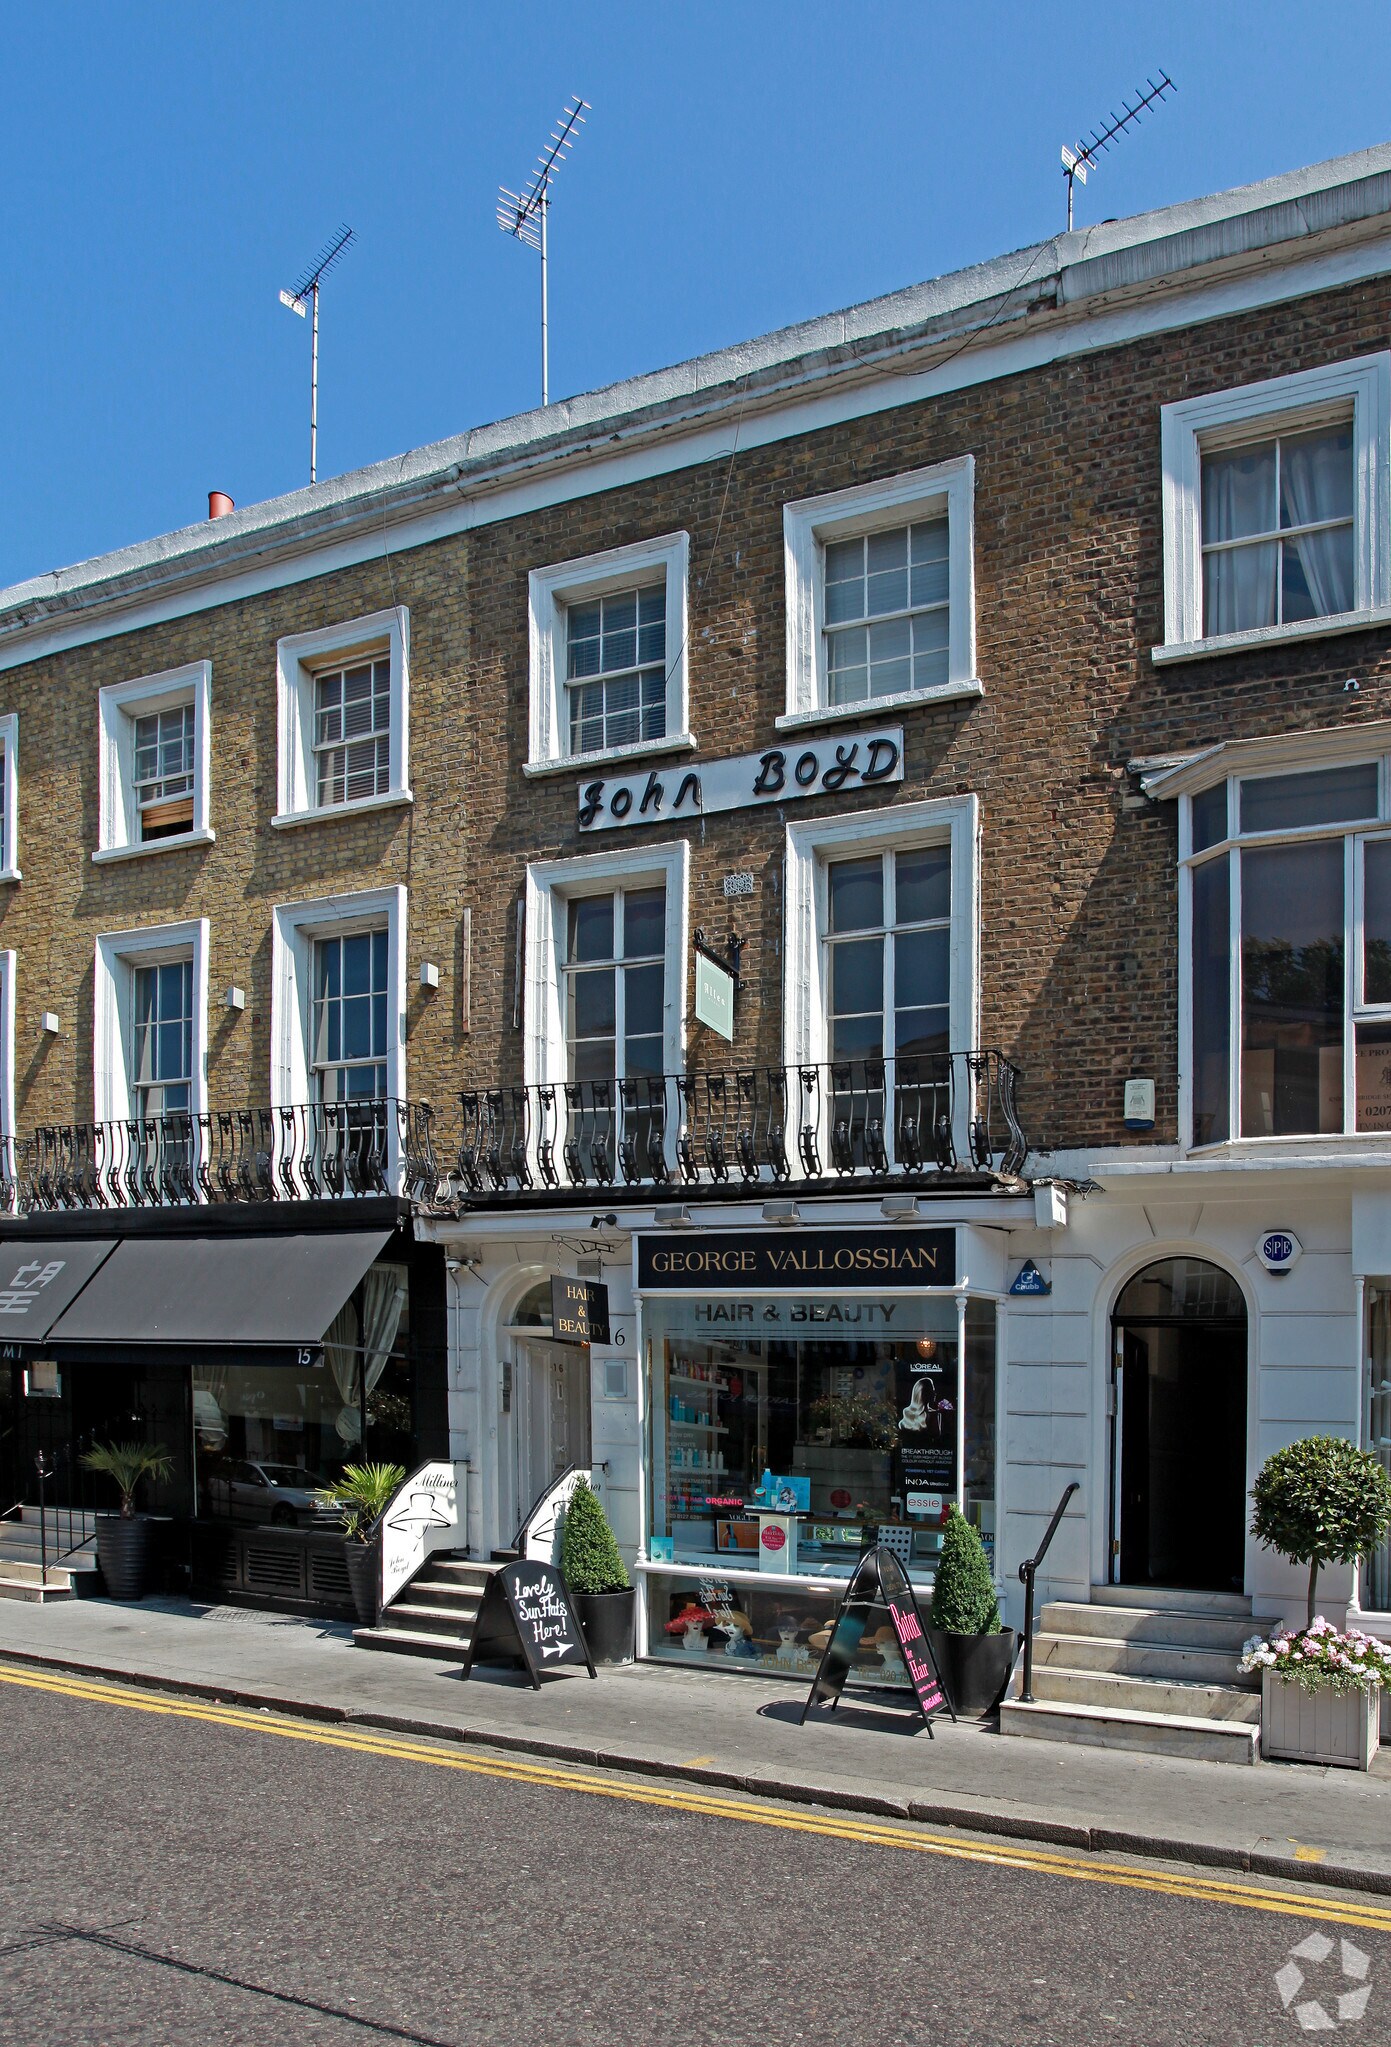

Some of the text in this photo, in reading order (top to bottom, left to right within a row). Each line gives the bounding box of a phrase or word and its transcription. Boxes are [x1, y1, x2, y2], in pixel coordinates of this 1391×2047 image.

[652, 1247, 938, 1272] GEORGE VALLOSSIAN
[567, 1285, 595, 1302] HAIR
[578, 1305, 586, 1317] &
[695, 1303, 897, 1322] HAIR & BEAUTY
[559, 1318, 605, 1336] BEAUTY
[298, 1348, 311, 1364] 15
[901, 1448, 953, 1456] BREAKTHROUGH
[415, 1474, 459, 1488] Milliner
[705, 1497, 743, 1506] ORGANIC
[908, 1499, 940, 1507] essie
[515, 1575, 555, 1600] Lovely
[533, 1617, 567, 1642] Here!
[890, 1604, 922, 1644] Botox
[905, 1647, 914, 1660] for
[759, 1655, 820, 1673] JOHN BOY
[909, 1658, 929, 1682] Hair
[922, 1692, 943, 1711] ORGANIC
